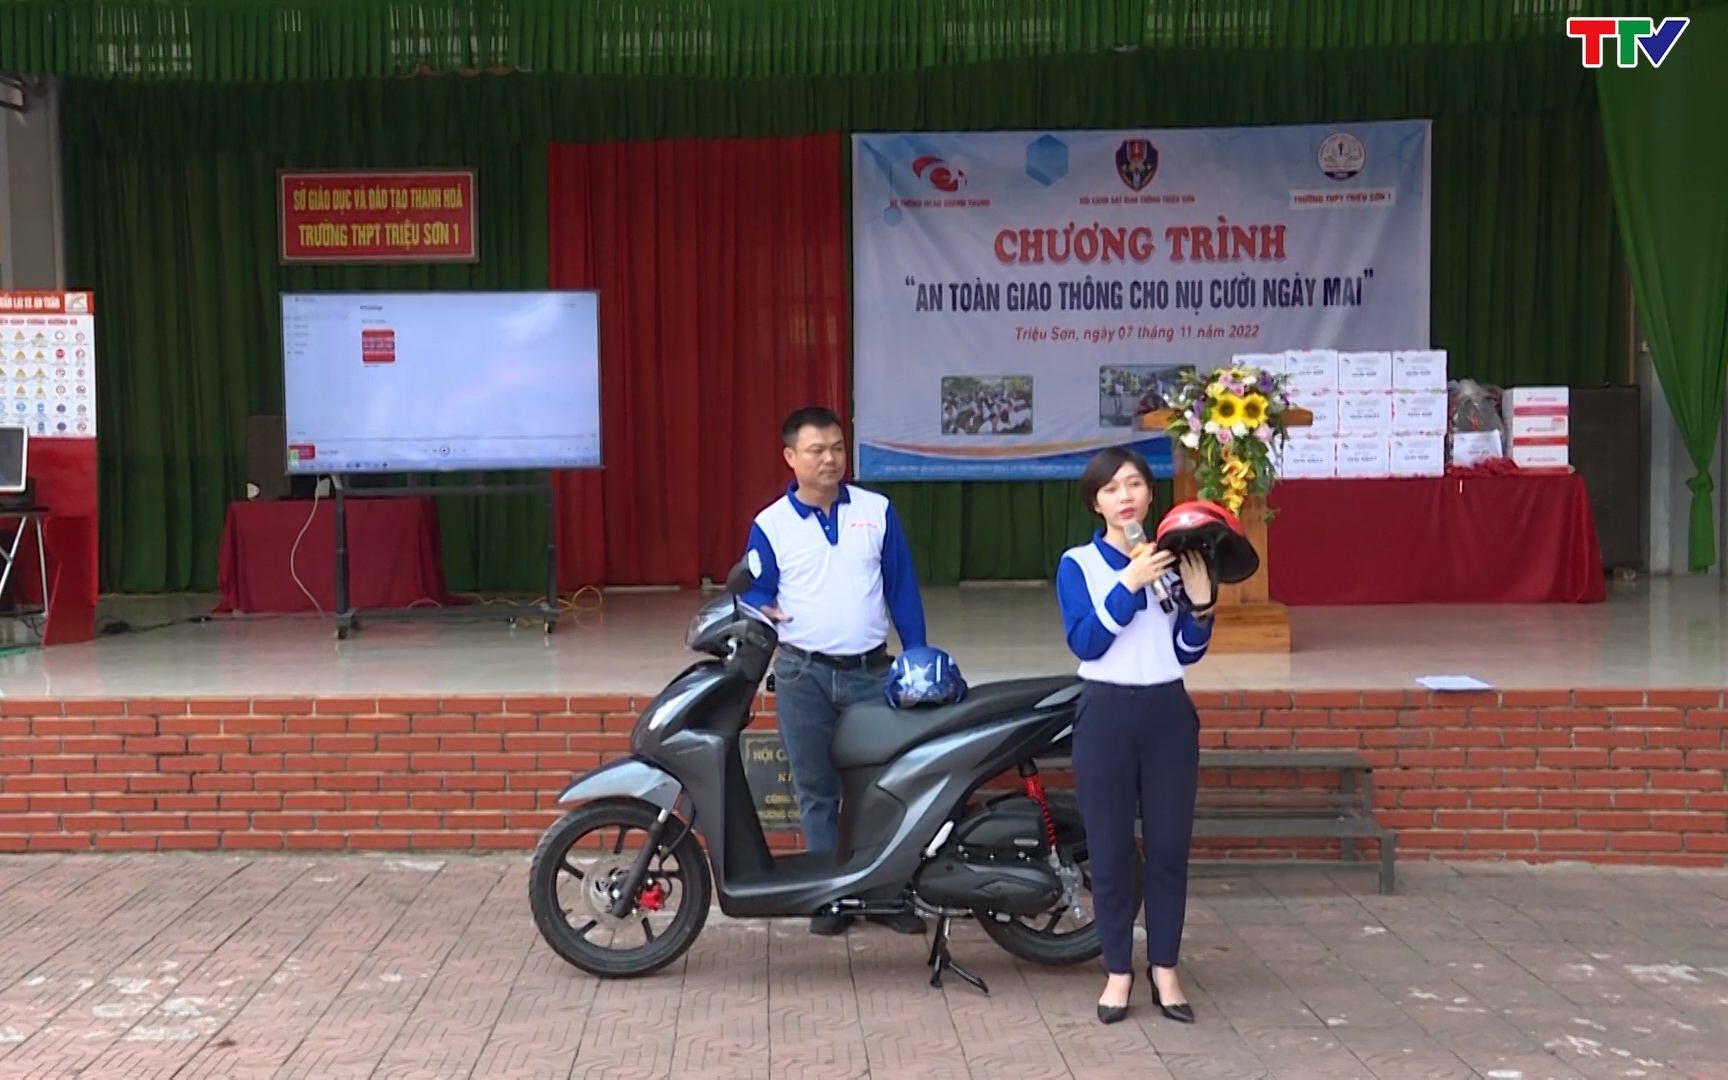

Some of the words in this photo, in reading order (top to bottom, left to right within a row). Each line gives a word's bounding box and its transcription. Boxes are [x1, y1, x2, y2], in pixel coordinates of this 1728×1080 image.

[308, 186, 330, 210] GIÁO
[354, 185, 367, 209] VÀ
[390, 188, 408, 214] TẠO
[410, 188, 441, 209] THANH
[299, 219, 348, 246] TRƯỜNG
[351, 223, 381, 246] THPT
[385, 218, 420, 250] TRIỆU
[423, 221, 449, 245] SƠN
[453, 223, 459, 246] 1
[994, 221, 1155, 263] CHƯƠNG
[1165, 215, 1288, 262] TRÌNH
[948, 276, 1000, 312] TOÀN
[1006, 281, 1051, 311] GIAO
[1058, 274, 1123, 311] THÔNG
[1130, 279, 1169, 310] CHO
[1175, 279, 1203, 316] NỤ
[1210, 271, 1256, 309] CƯỜI
[1262, 271, 1316, 308] NGÀY
[1016, 325, 1047, 342] Triệu
[1051, 325, 1079, 341] Sơn,
[1083, 325, 1116, 344] ngày
[1118, 326, 1133, 340] 07
[1137, 325, 1174, 343] tháng
[1180, 325, 1192, 339] 11
[1197, 324, 1225, 339] năm
[1229, 324, 1260, 339] 2022
